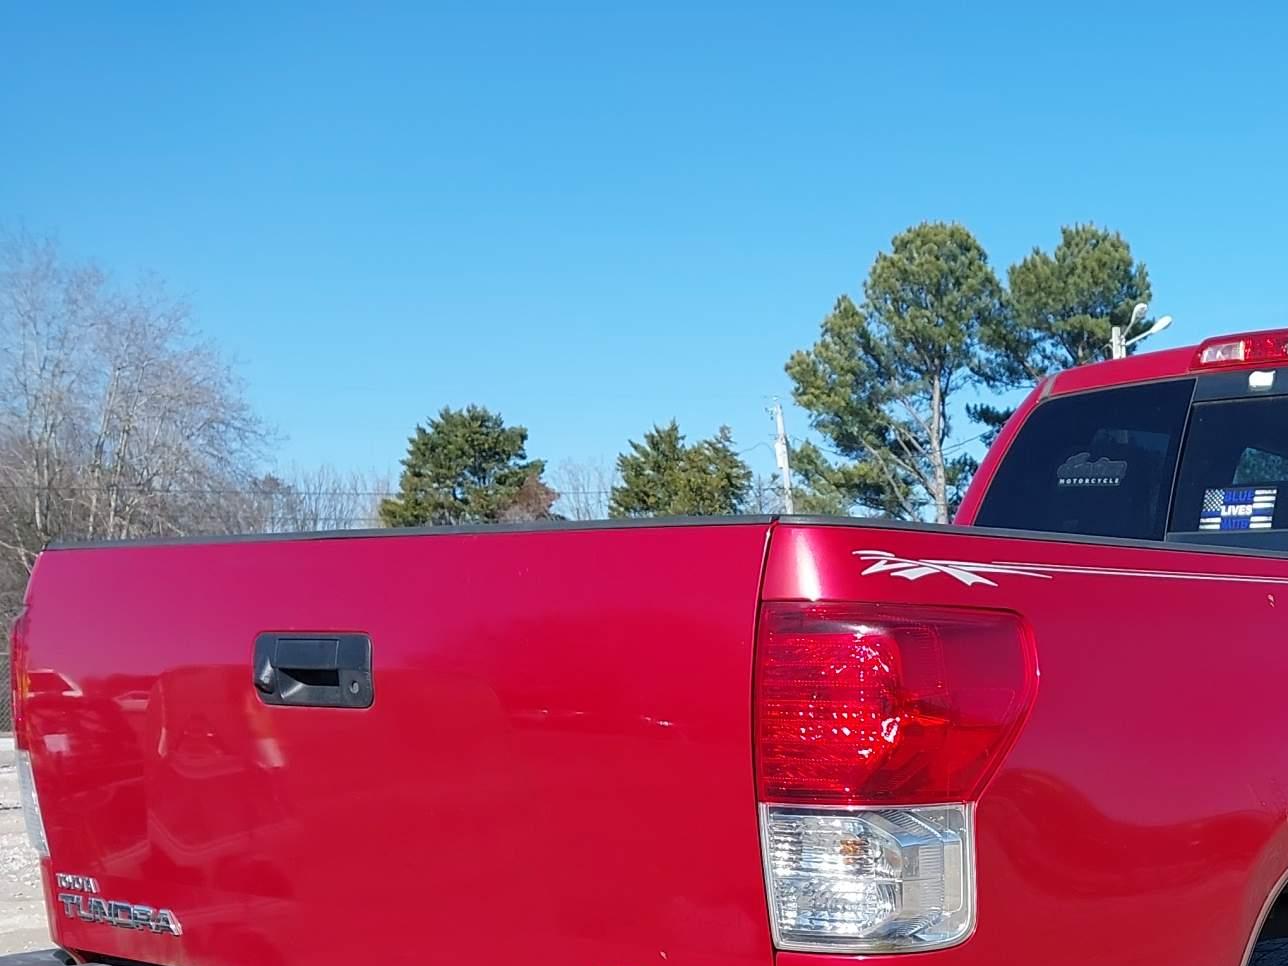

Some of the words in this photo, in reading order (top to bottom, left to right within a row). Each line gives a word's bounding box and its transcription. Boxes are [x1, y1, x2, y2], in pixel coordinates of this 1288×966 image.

[1223, 488, 1255, 503] BLUE
[1220, 502, 1253, 517] LIVES
[58, 893, 183, 936] TUNDRA
